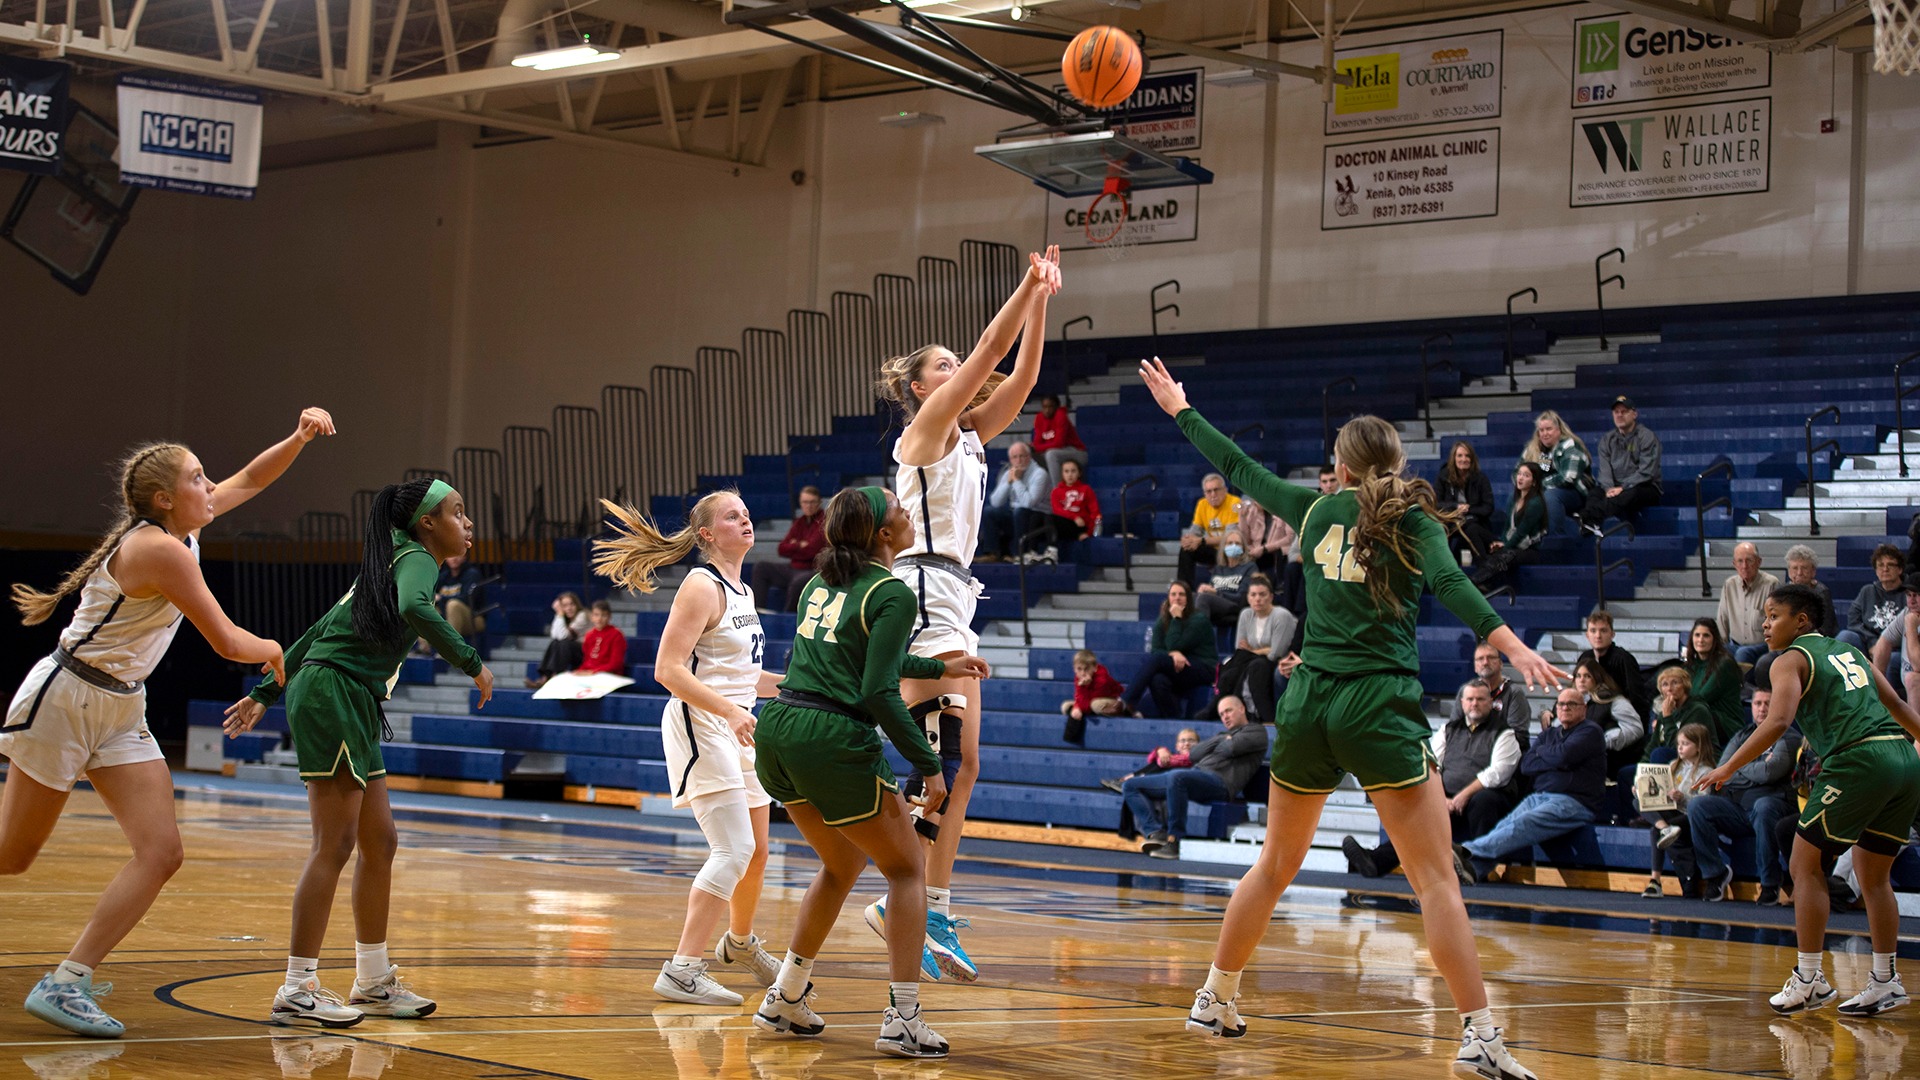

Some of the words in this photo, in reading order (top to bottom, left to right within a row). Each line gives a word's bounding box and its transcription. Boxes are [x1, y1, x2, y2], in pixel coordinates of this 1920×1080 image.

[1625, 27, 1743, 58] GenSe
[1406, 61, 1495, 87] COURTYARD
[1629, 78, 1664, 89] Influence
[1672, 73, 1700, 84] Broken
[1702, 70, 1725, 80] World
[1727, 68, 1743, 78] with
[1744, 66, 1757, 75] the
[1643, 65, 1663, 76] Live
[1667, 62, 1685, 73] Life
[1688, 61, 1702, 71] on
[1704, 55, 1744, 69] Mission
[1656, 83, 1698, 95] Life-Giving
[1700, 79, 1728, 90] Gospel
[1432, 103, 1494, 118] 937-322-3600
[142, 113, 232, 156] NCCAA
[1664, 109, 1761, 140] WALLACE
[1335, 149, 1386, 168] DOCTON
[1390, 145, 1439, 163] ANIMAL
[1442, 139, 1488, 157] CLINIC
[1662, 150, 1671, 170] &
[1680, 139, 1760, 168] TURNER
[1373, 171, 1384, 183] 10
[1387, 168, 1419, 182] Kinsey
[1422, 164, 1448, 177] Road
[1577, 179, 1627, 191] INSURANCE
[1628, 175, 1676, 187] COVERAGE
[1677, 174, 1688, 183] IN
[1688, 172, 1711, 182] OHIO
[1713, 169, 1739, 180] SINCE
[1742, 168, 1761, 177] 1870
[1366, 187, 1396, 201] Xenia,
[1399, 184, 1421, 196] Ohio
[1423, 181, 1454, 194] 45385
[1373, 204, 1397, 219] (937)
[1400, 201, 1444, 216] 372-6391
[1314, 523, 1367, 583] 42
[797, 587, 848, 643] 24
[1828, 651, 1869, 691] 15
[1640, 766, 1669, 775] GAMEDAY
